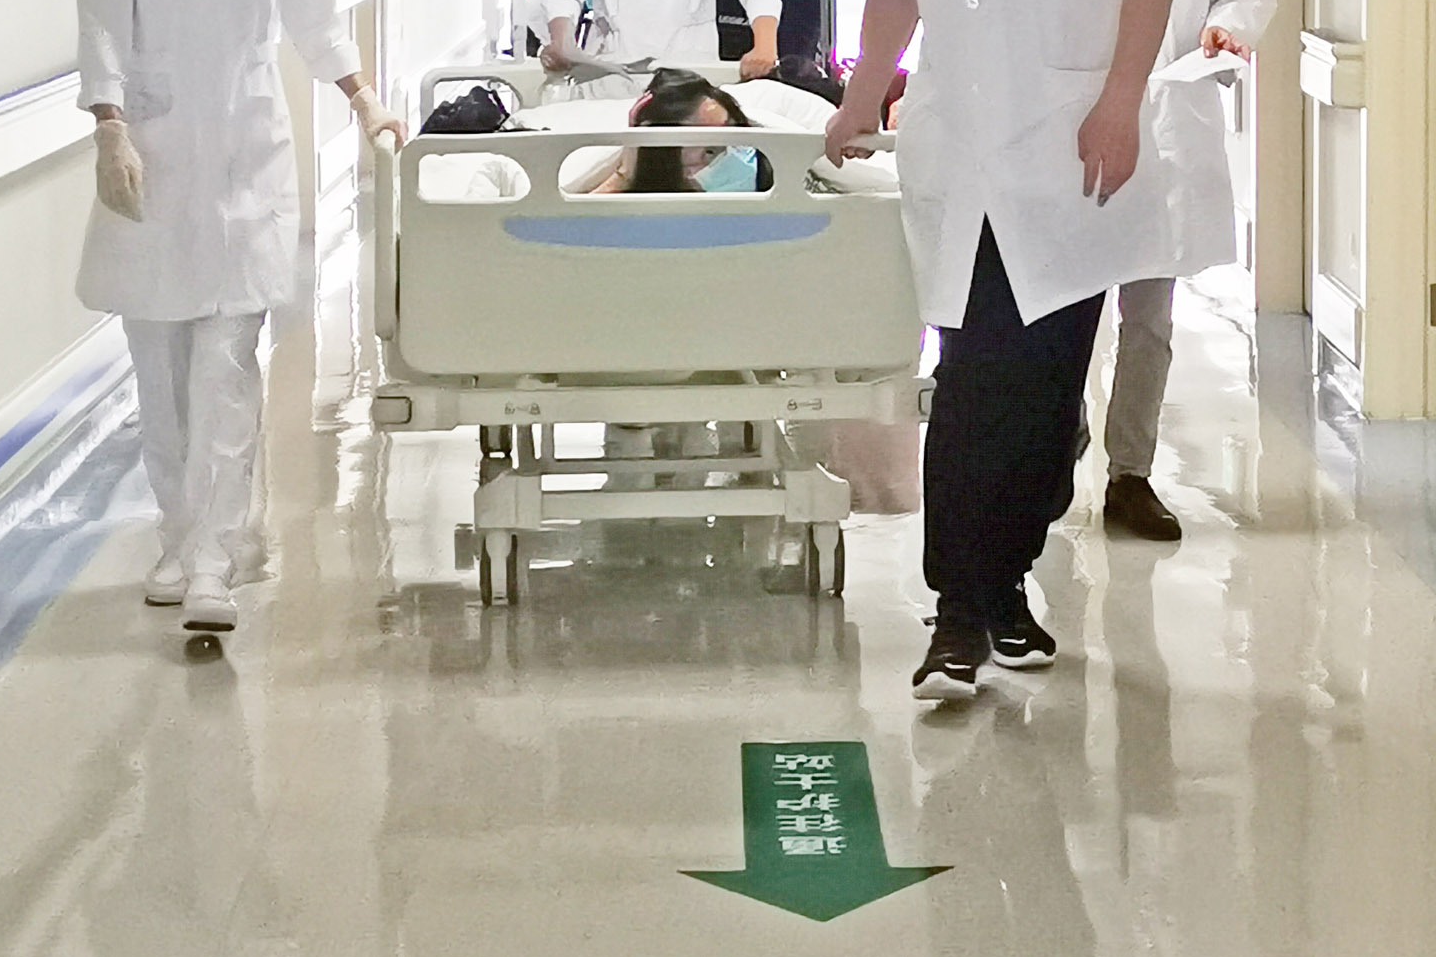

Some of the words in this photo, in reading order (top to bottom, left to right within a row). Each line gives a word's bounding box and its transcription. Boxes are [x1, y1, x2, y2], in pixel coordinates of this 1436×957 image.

[772, 754, 847, 855] 通往护士站
